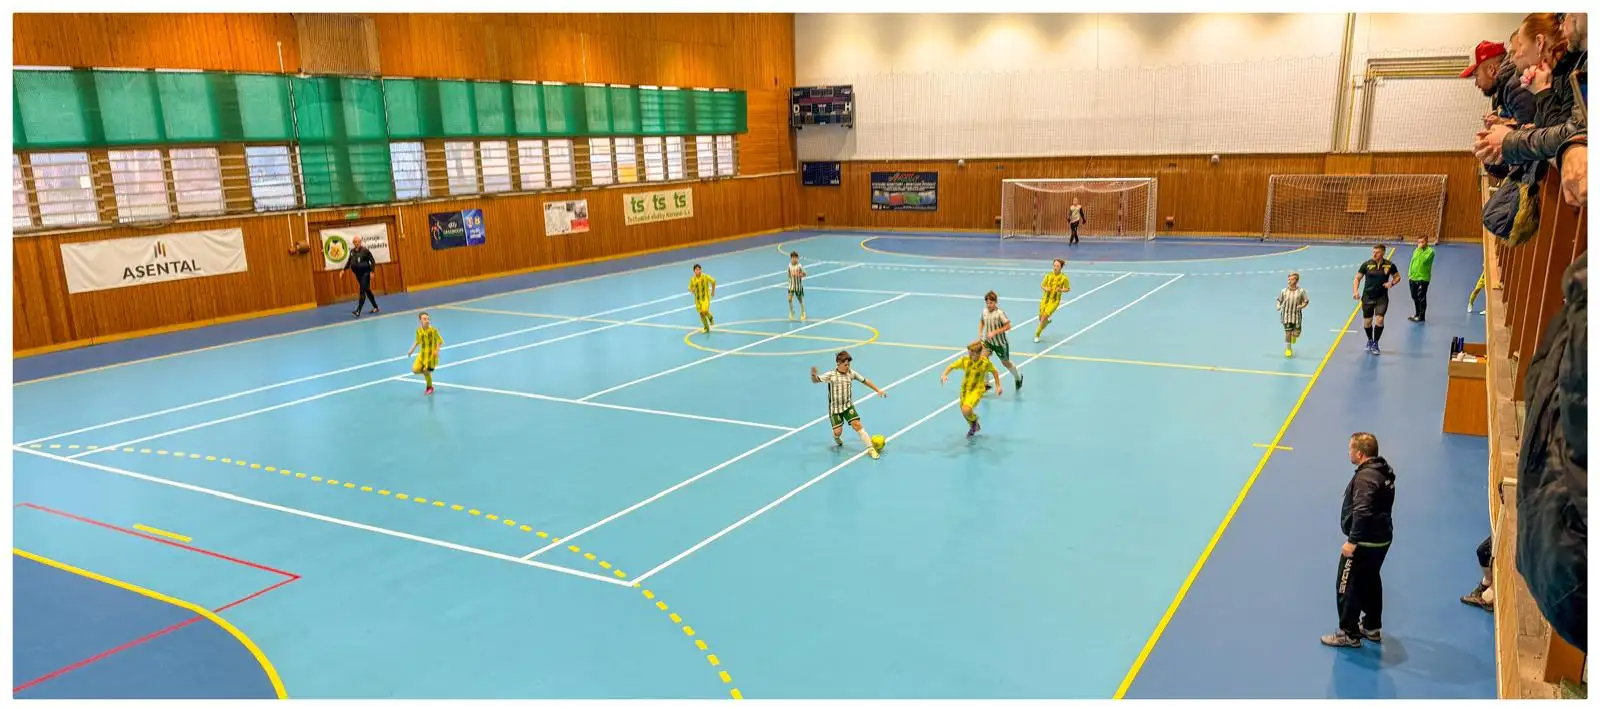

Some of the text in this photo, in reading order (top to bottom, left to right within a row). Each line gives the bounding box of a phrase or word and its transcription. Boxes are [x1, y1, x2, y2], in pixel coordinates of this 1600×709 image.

[844, 102, 851, 111] H
[630, 192, 687, 213] ts ts ts
[122, 259, 201, 280] ASENTAL
